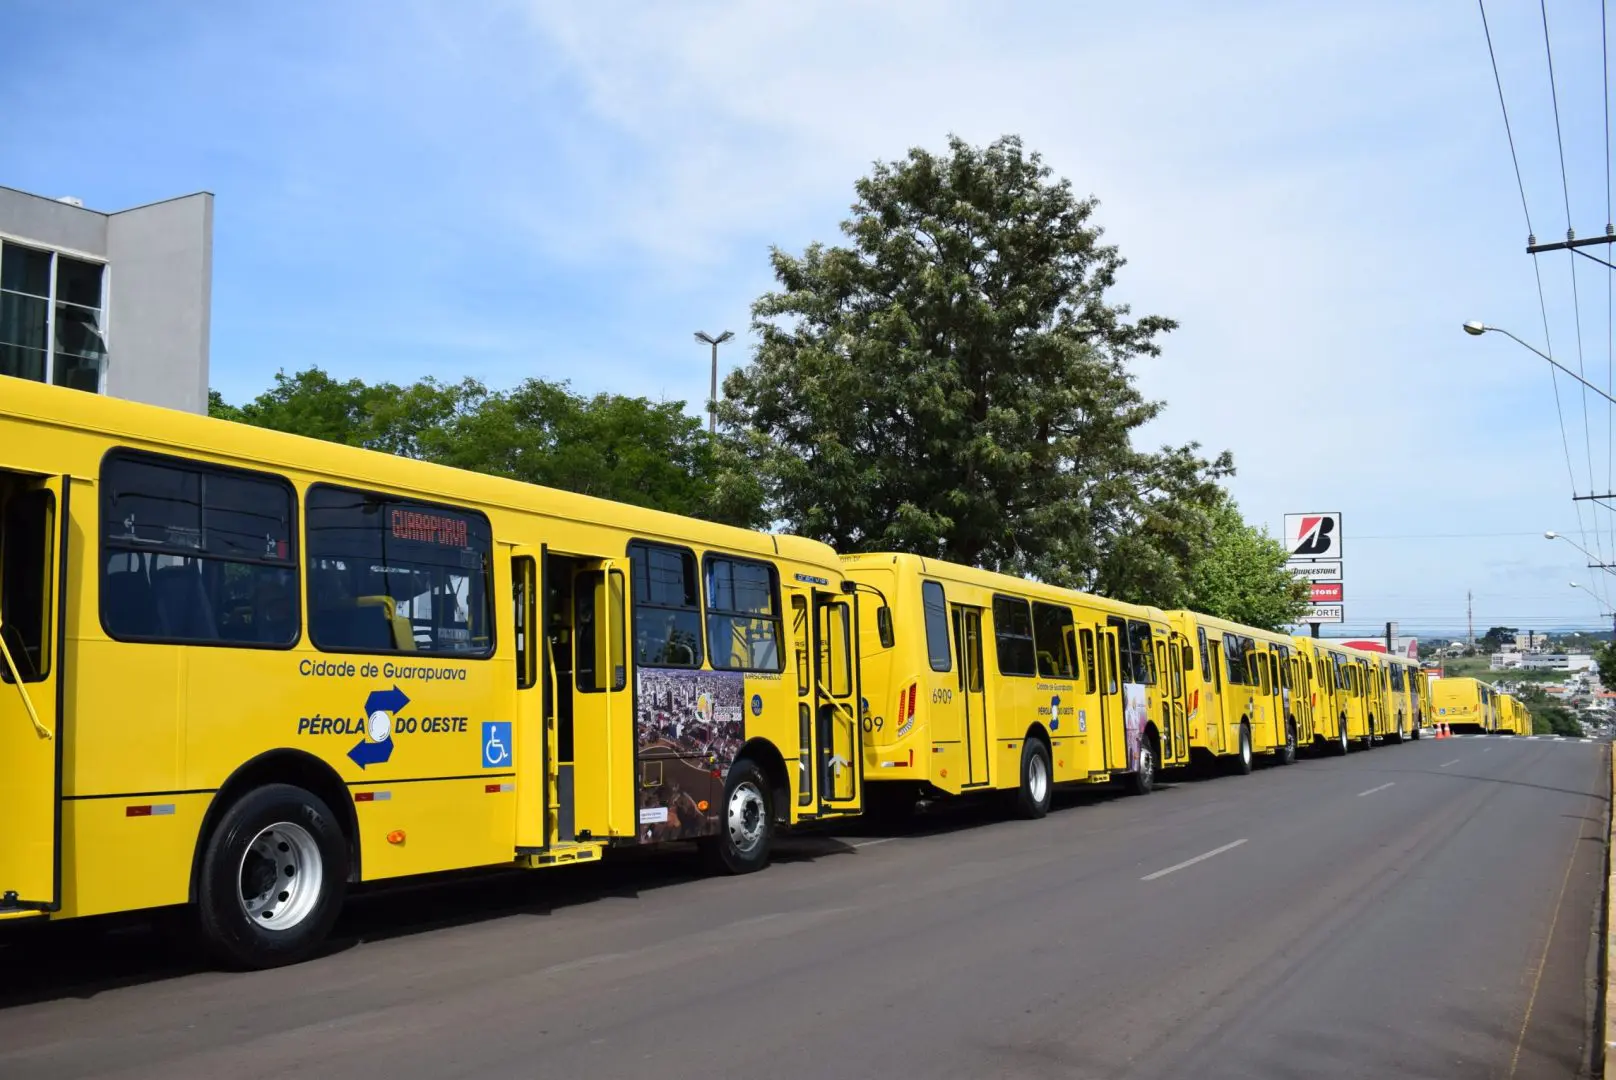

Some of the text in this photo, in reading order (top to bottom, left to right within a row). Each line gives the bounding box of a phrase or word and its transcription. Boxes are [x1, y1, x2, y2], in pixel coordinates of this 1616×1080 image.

[299, 659, 467, 682] Cidade de Guarapuava
[932, 688, 952, 704] 6909
[297, 714, 468, 735] PÉROLA DO OESTE
